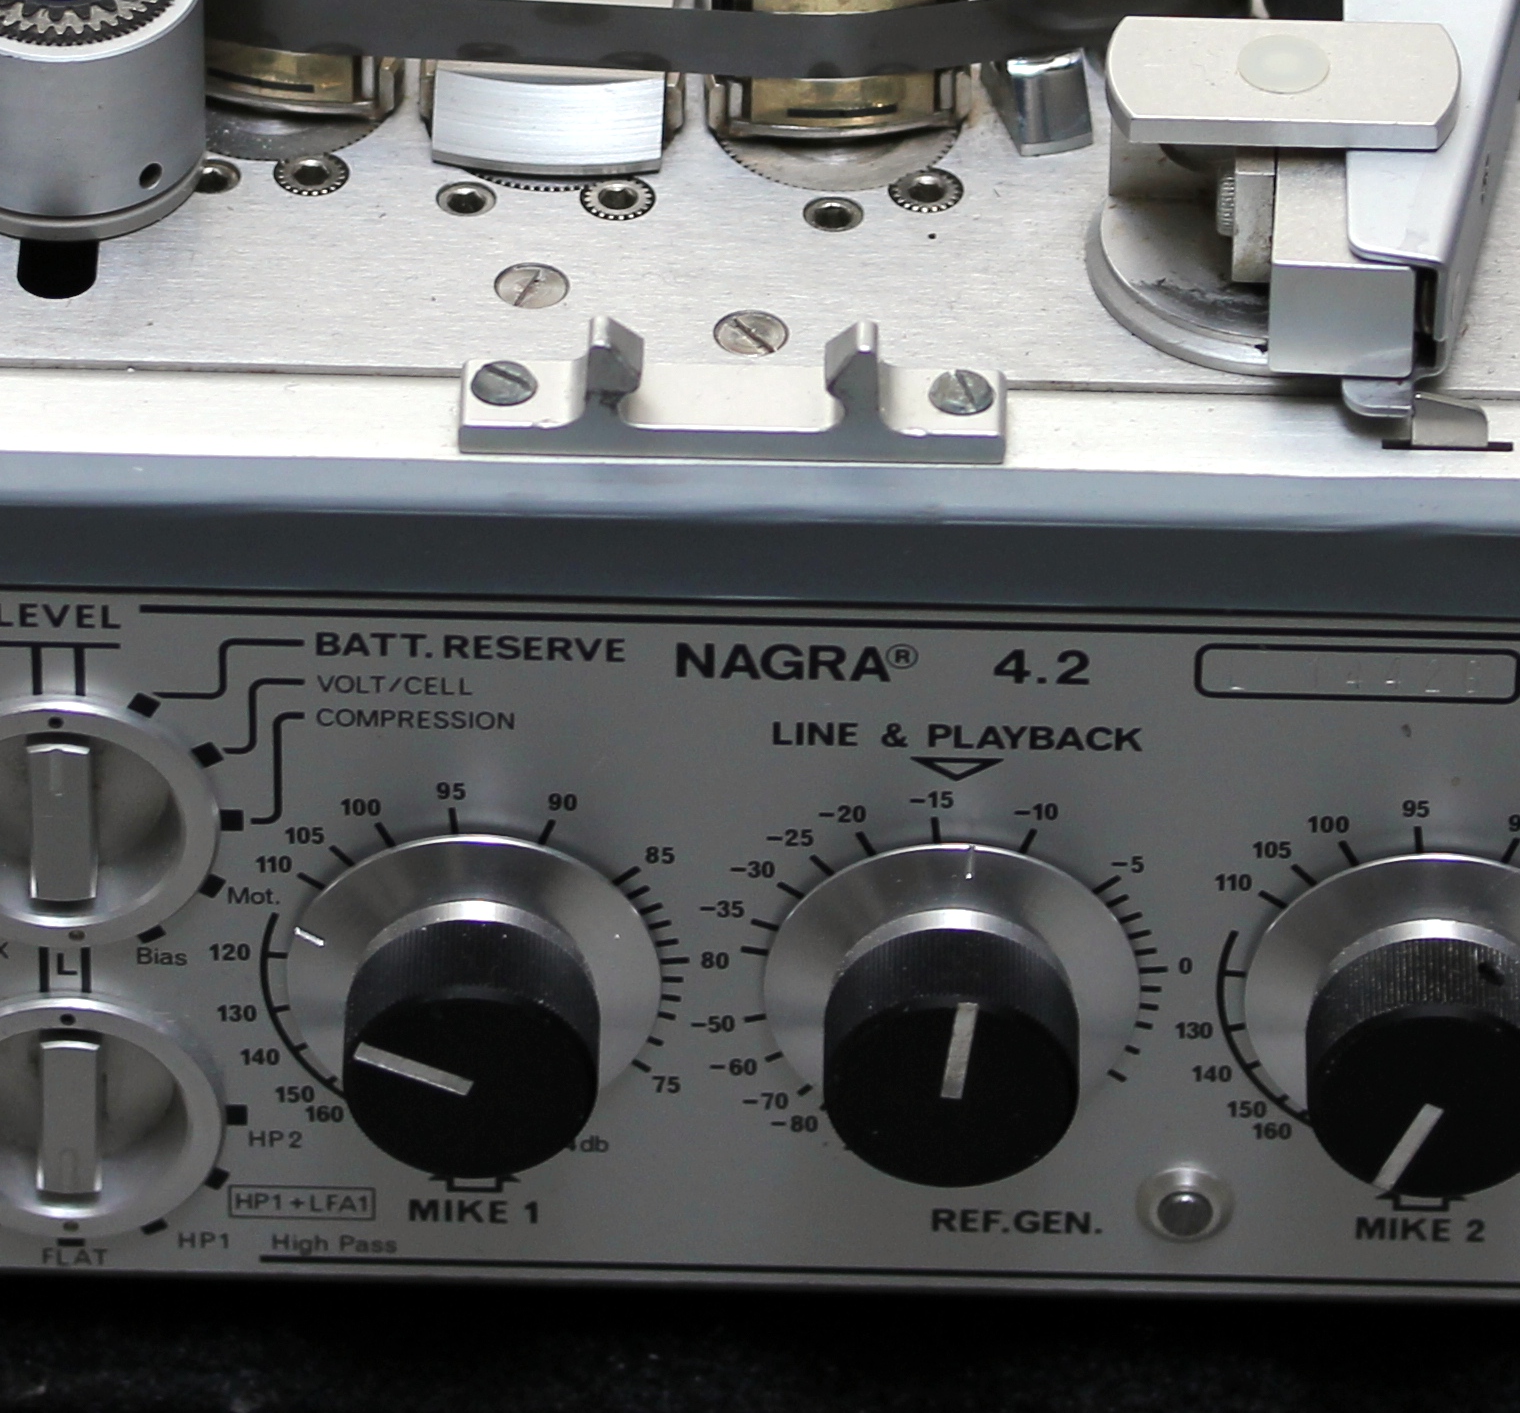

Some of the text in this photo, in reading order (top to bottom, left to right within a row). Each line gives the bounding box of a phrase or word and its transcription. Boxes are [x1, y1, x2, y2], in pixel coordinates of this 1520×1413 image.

[315, 632, 626, 664] BATT. RESERVE
[994, 650, 1090, 686] 4.2
[316, 675, 473, 697] VOLT/CELL
[316, 708, 515, 731] COMPRESSION
[771, 721, 1143, 753] LINE & PLAYBACK
[436, 783, 466, 801] 95
[910, 792, 953, 809] -15
[341, 798, 380, 816] 100
[549, 794, 577, 812] 90
[1014, 803, 1059, 821] -10
[1402, 800, 1430, 819] 95
[819, 805, 866, 823] -20
[1307, 815, 1349, 834] 100
[285, 827, 325, 845] 105
[766, 830, 814, 847] -25
[646, 847, 675, 865] 85
[1253, 841, 1291, 859] 105
[255, 856, 292, 874] 110
[730, 861, 775, 879] -30
[1111, 856, 1144, 874] -5
[1215, 873, 1252, 891] 110
[227, 887, 280, 908] Mot.
[700, 900, 744, 917] -35
[136, 946, 187, 968] Bias
[209, 943, 250, 961] 120
[700, 952, 729, 970] 80
[57, 953, 77, 977] L
[1179, 957, 1192, 975] 0
[217, 1005, 257, 1022] 130
[691, 1015, 735, 1033] -50
[1175, 1022, 1212, 1039] 130
[240, 1049, 279, 1066] 140
[710, 1058, 757, 1076] -60
[1192, 1066, 1232, 1082] 140
[653, 1076, 680, 1094] 75
[276, 1086, 315, 1104] 150
[743, 1093, 788, 1110] -70
[306, 1105, 344, 1123] 160
[1227, 1102, 1266, 1118] 150
[771, 1115, 818, 1133] -80
[1253, 1123, 1292, 1140] 160
[408, 1199, 539, 1225] MIKE 1
[1355, 1217, 1485, 1242] MIKE 2
[179, 1232, 230, 1250] HP1
[272, 1235, 397, 1255] High Pass
[42, 1247, 108, 1266] FLAT
